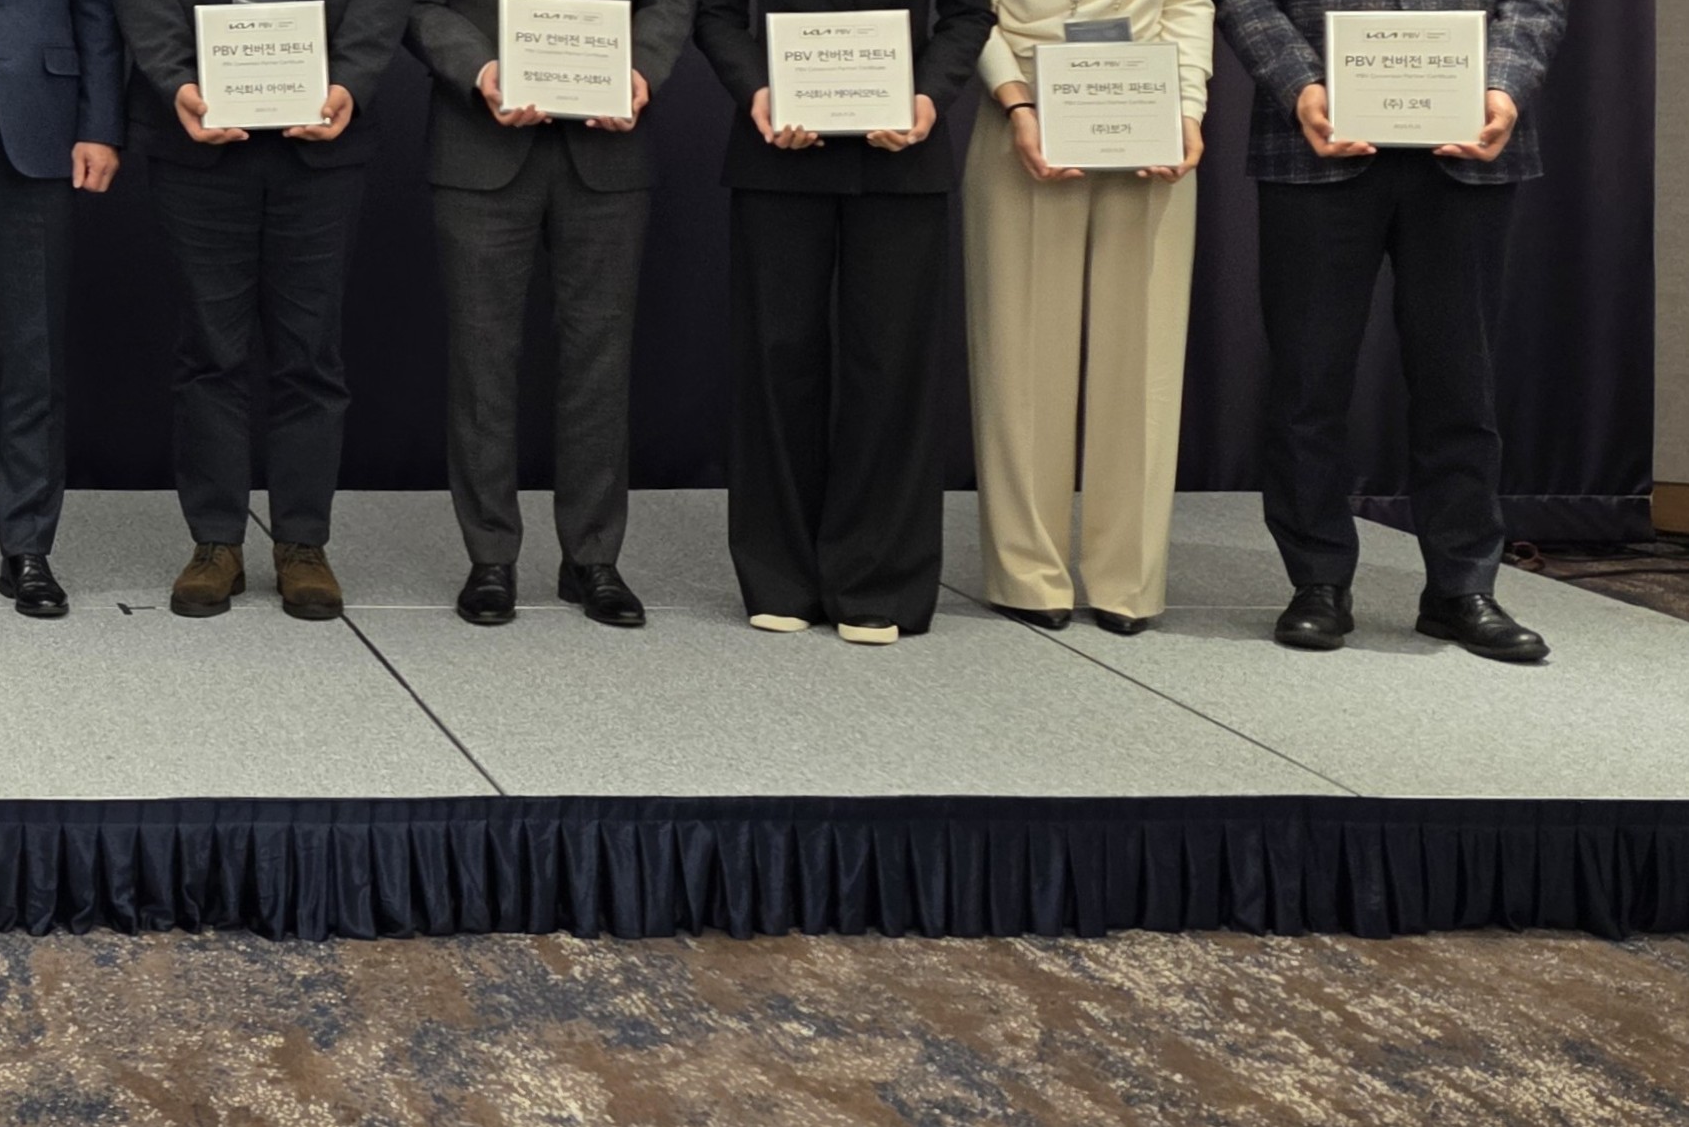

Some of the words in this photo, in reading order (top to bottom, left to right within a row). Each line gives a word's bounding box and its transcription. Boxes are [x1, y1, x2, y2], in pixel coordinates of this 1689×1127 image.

[515, 32, 542, 43] PBV
[546, 34, 580, 47] 컨버전
[584, 36, 618, 49] 파트너
[212, 45, 238, 56] PBV
[243, 43, 275, 56] 컨버전
[280, 42, 314, 54] 파트너
[784, 51, 813, 62] PBV
[817, 49, 854, 62] 컨버전
[859, 48, 896, 60] 파트너
[1345, 55, 1376, 67] PBV
[1382, 55, 1422, 68] 컨버전
[1428, 55, 1469, 68] 파트너
[573, 73, 612, 85] 주식회사
[224, 84, 263, 95] 주식회사
[266, 83, 306, 94] 아이버스
[794, 90, 831, 99] 주식회사
[1053, 84, 1082, 94] PBV
[1085, 82, 1123, 96] 컨버전
[1128, 82, 1166, 94] 파트너
[1383, 98, 1403, 110] (주)
[1407, 98, 1431, 109] 오텍
